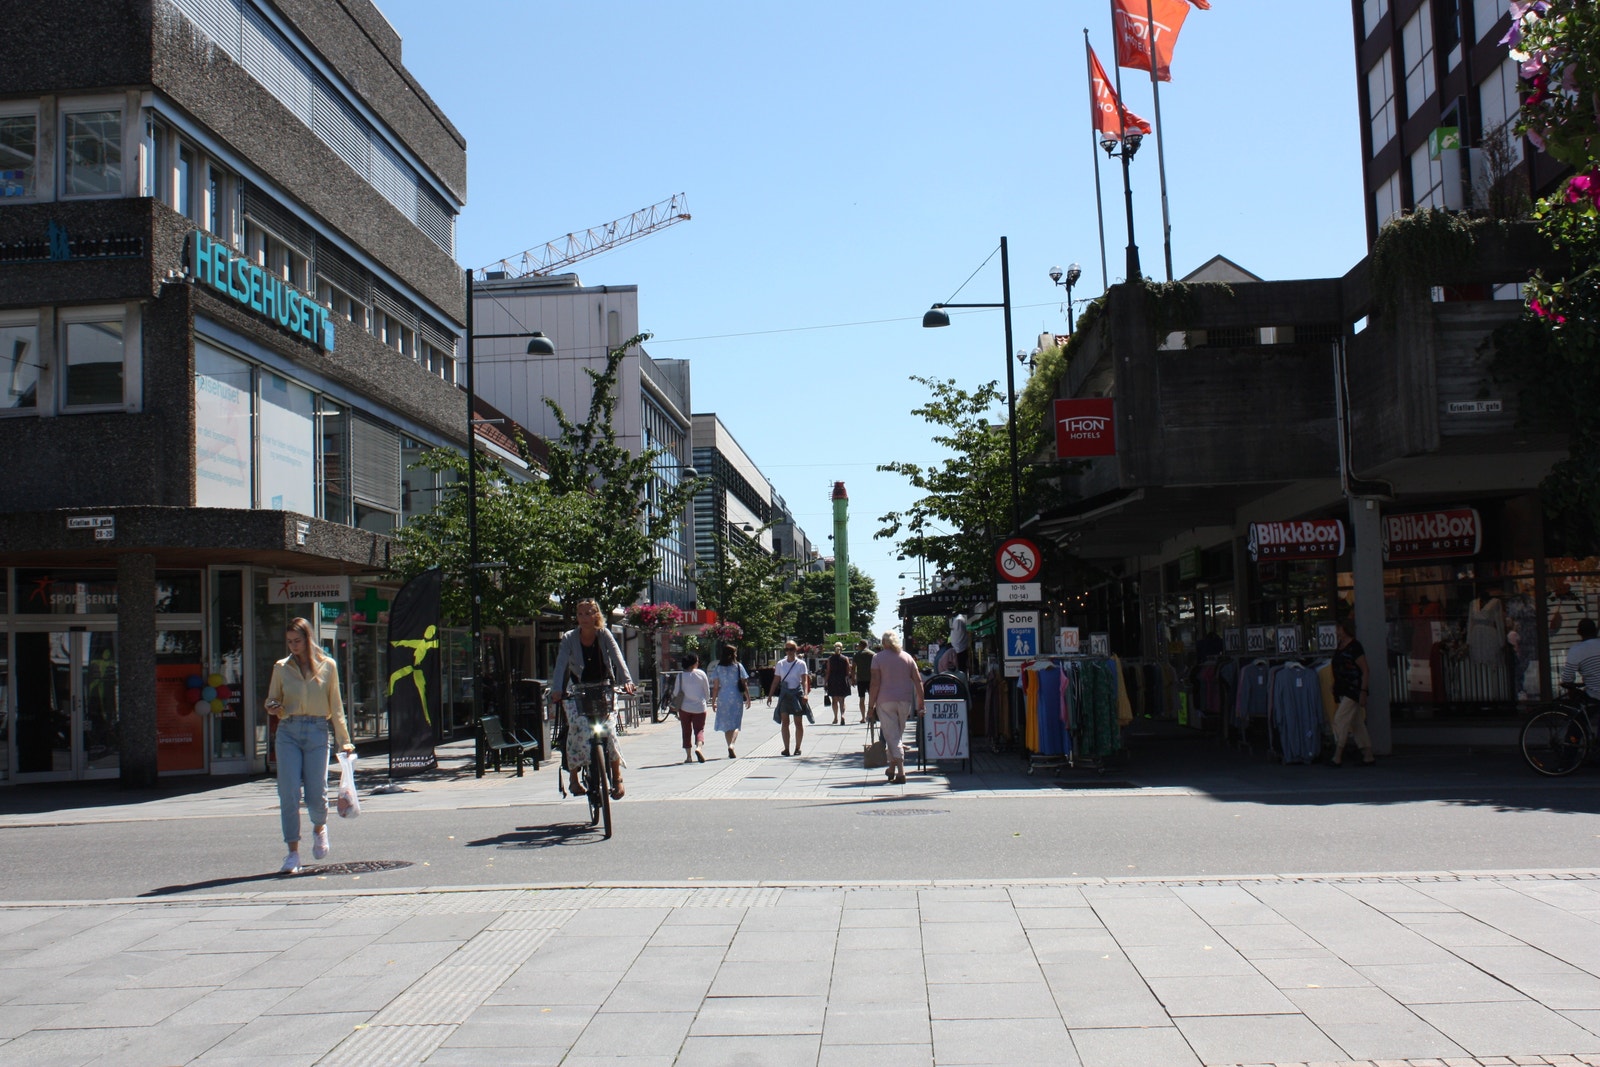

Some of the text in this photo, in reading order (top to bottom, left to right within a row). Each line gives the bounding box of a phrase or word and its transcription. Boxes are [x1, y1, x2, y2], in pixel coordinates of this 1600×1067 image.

[196, 230, 320, 344] HELSEHUSET
[1450, 403, 1475, 412] Kristian
[1058, 416, 1111, 432] THON
[1070, 431, 1101, 440] HOTELS
[1257, 521, 1339, 545] BlikkBox
[1389, 513, 1475, 542] BlikkBox
[1263, 544, 1335, 554] DIN MOTE
[1395, 538, 1470, 552] DIN MOTE
[290, 590, 340, 599] SPORTSENTER
[1008, 614, 1033, 624] Sone
[1062, 631, 1079, 648] 150
[1279, 634, 1295, 653] 300
[1319, 632, 1335, 648] 300
